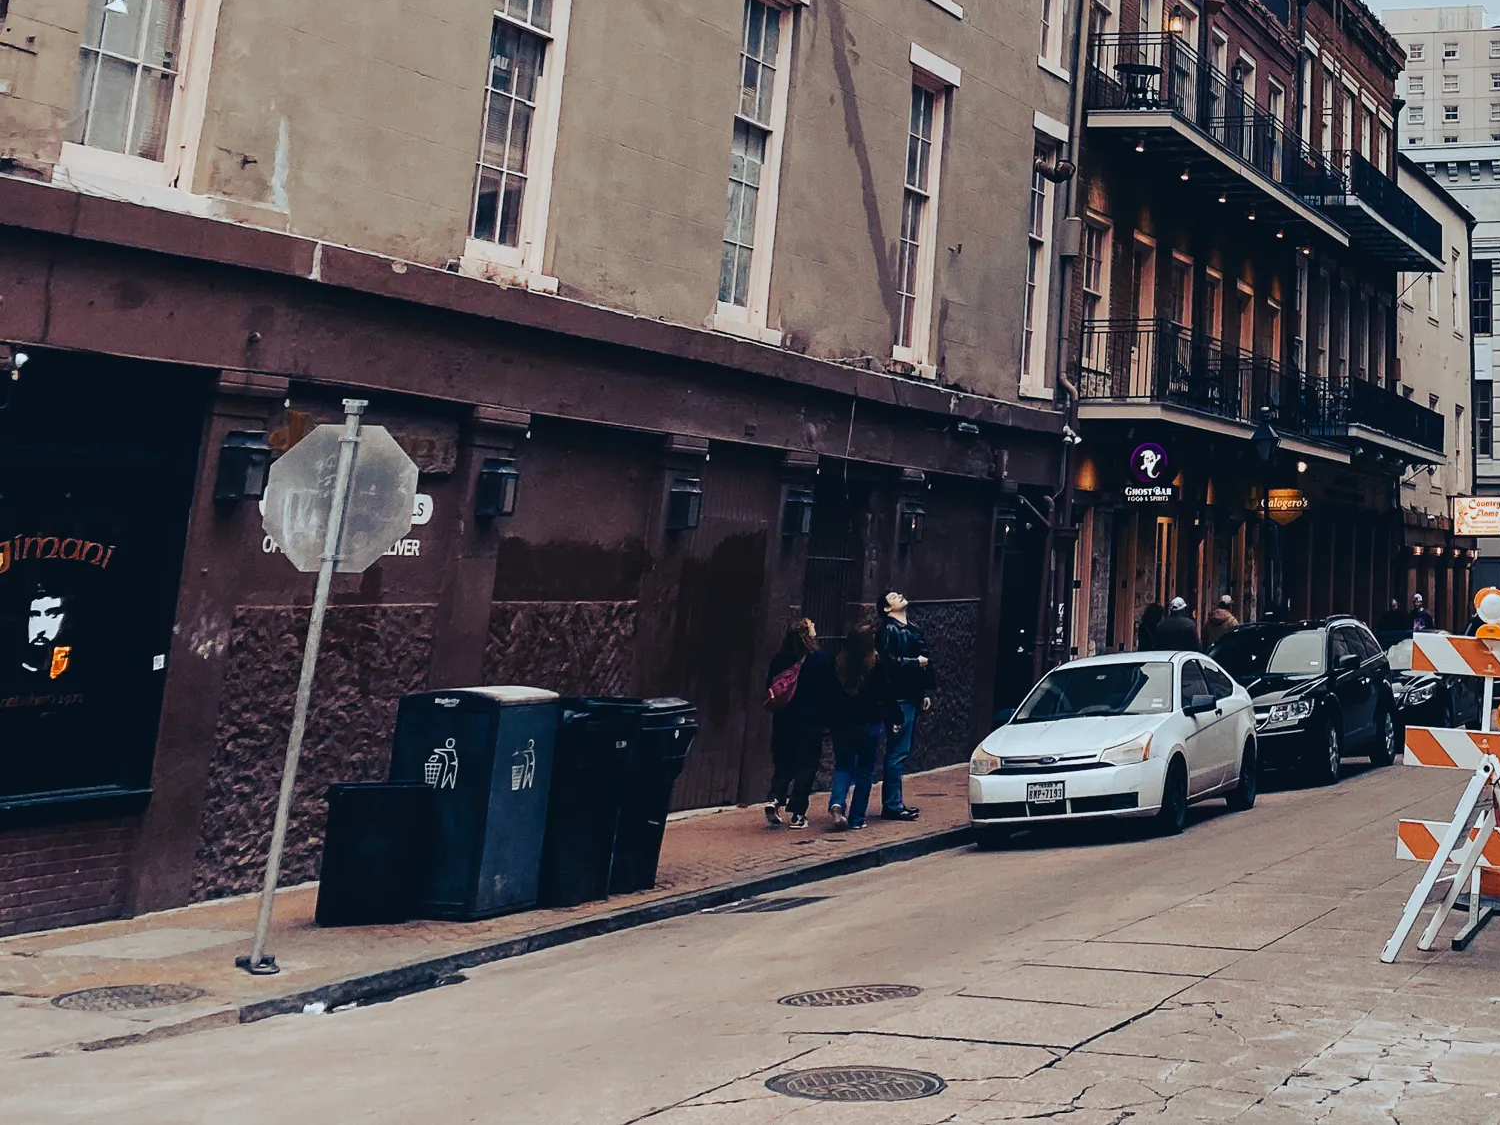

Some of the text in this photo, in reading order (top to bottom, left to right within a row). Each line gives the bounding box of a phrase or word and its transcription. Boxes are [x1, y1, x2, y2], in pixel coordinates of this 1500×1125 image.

[1124, 486, 1172, 496] GHOST BAR
[1468, 499, 1500, 509] Country
[1470, 509, 1499, 519] Flame
